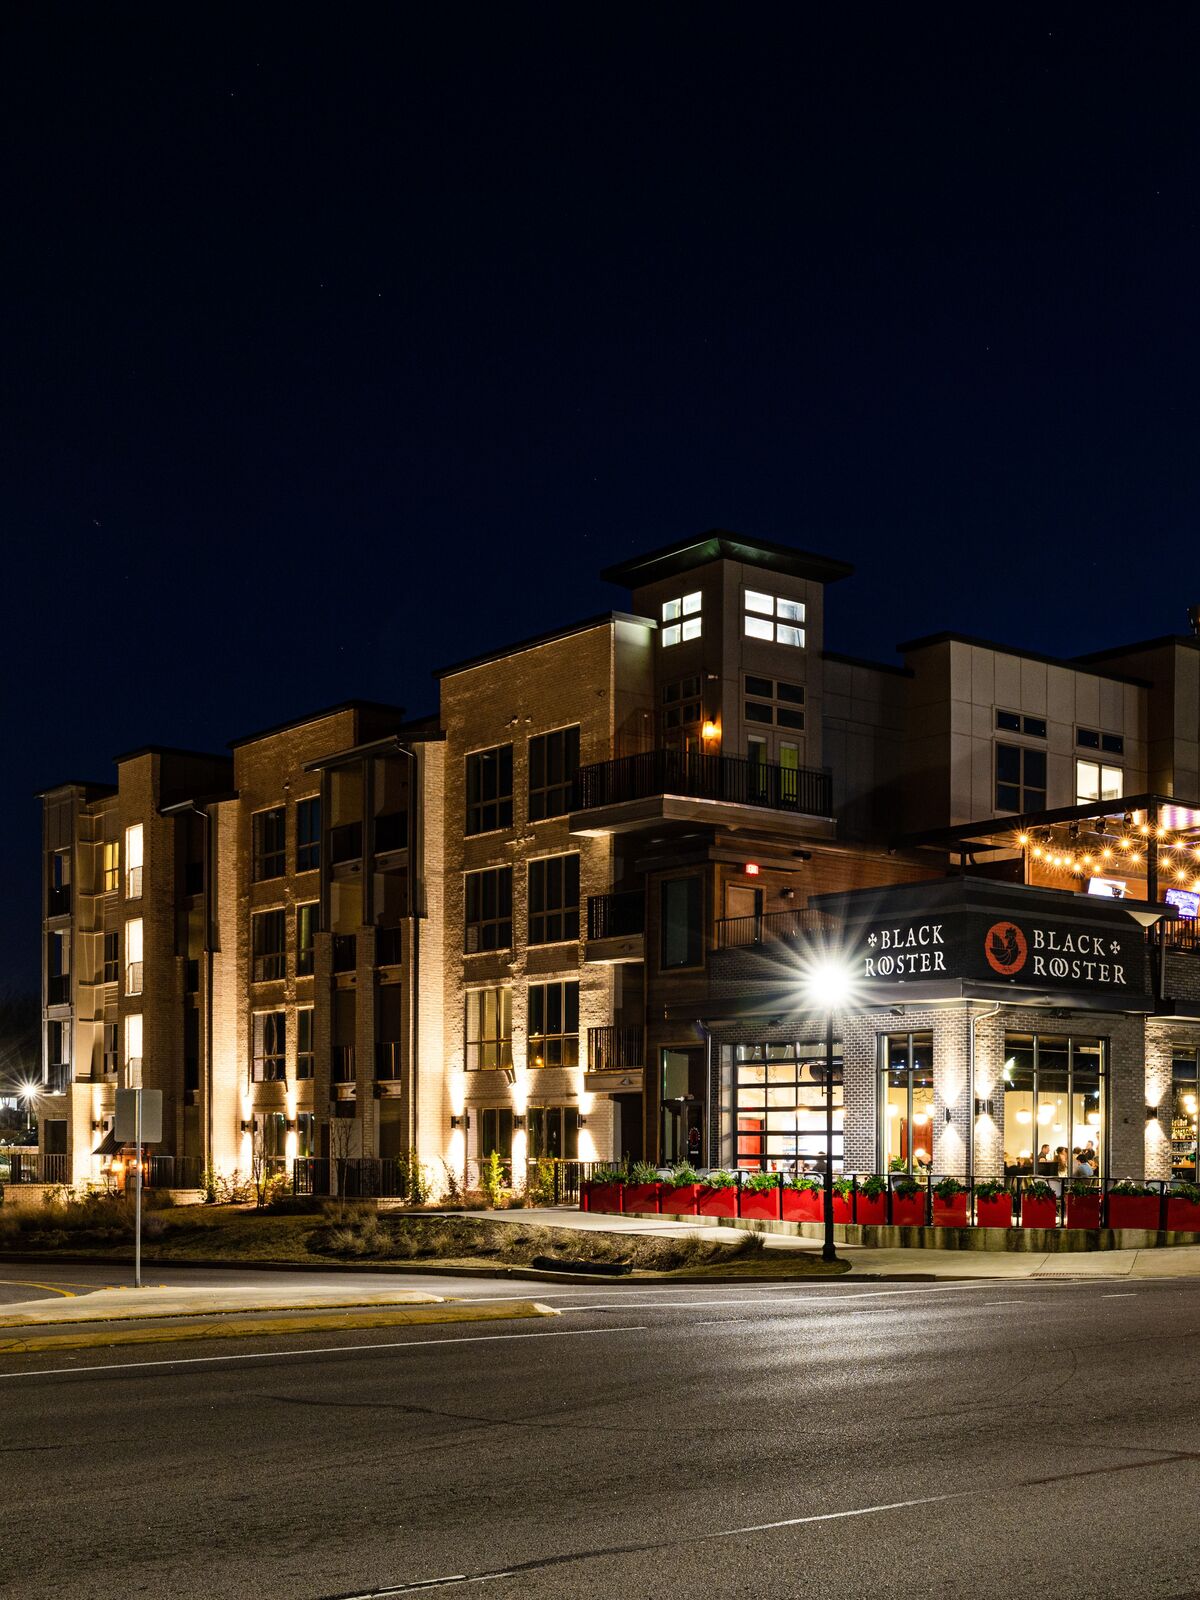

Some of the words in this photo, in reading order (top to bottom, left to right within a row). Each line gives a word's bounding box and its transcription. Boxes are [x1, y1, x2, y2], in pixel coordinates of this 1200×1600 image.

[881, 925, 944, 949] BLACK
[1033, 929, 1105, 956] BLACK
[864, 951, 946, 977] ROOSTER
[1033, 956, 1126, 985] ROOSTER
